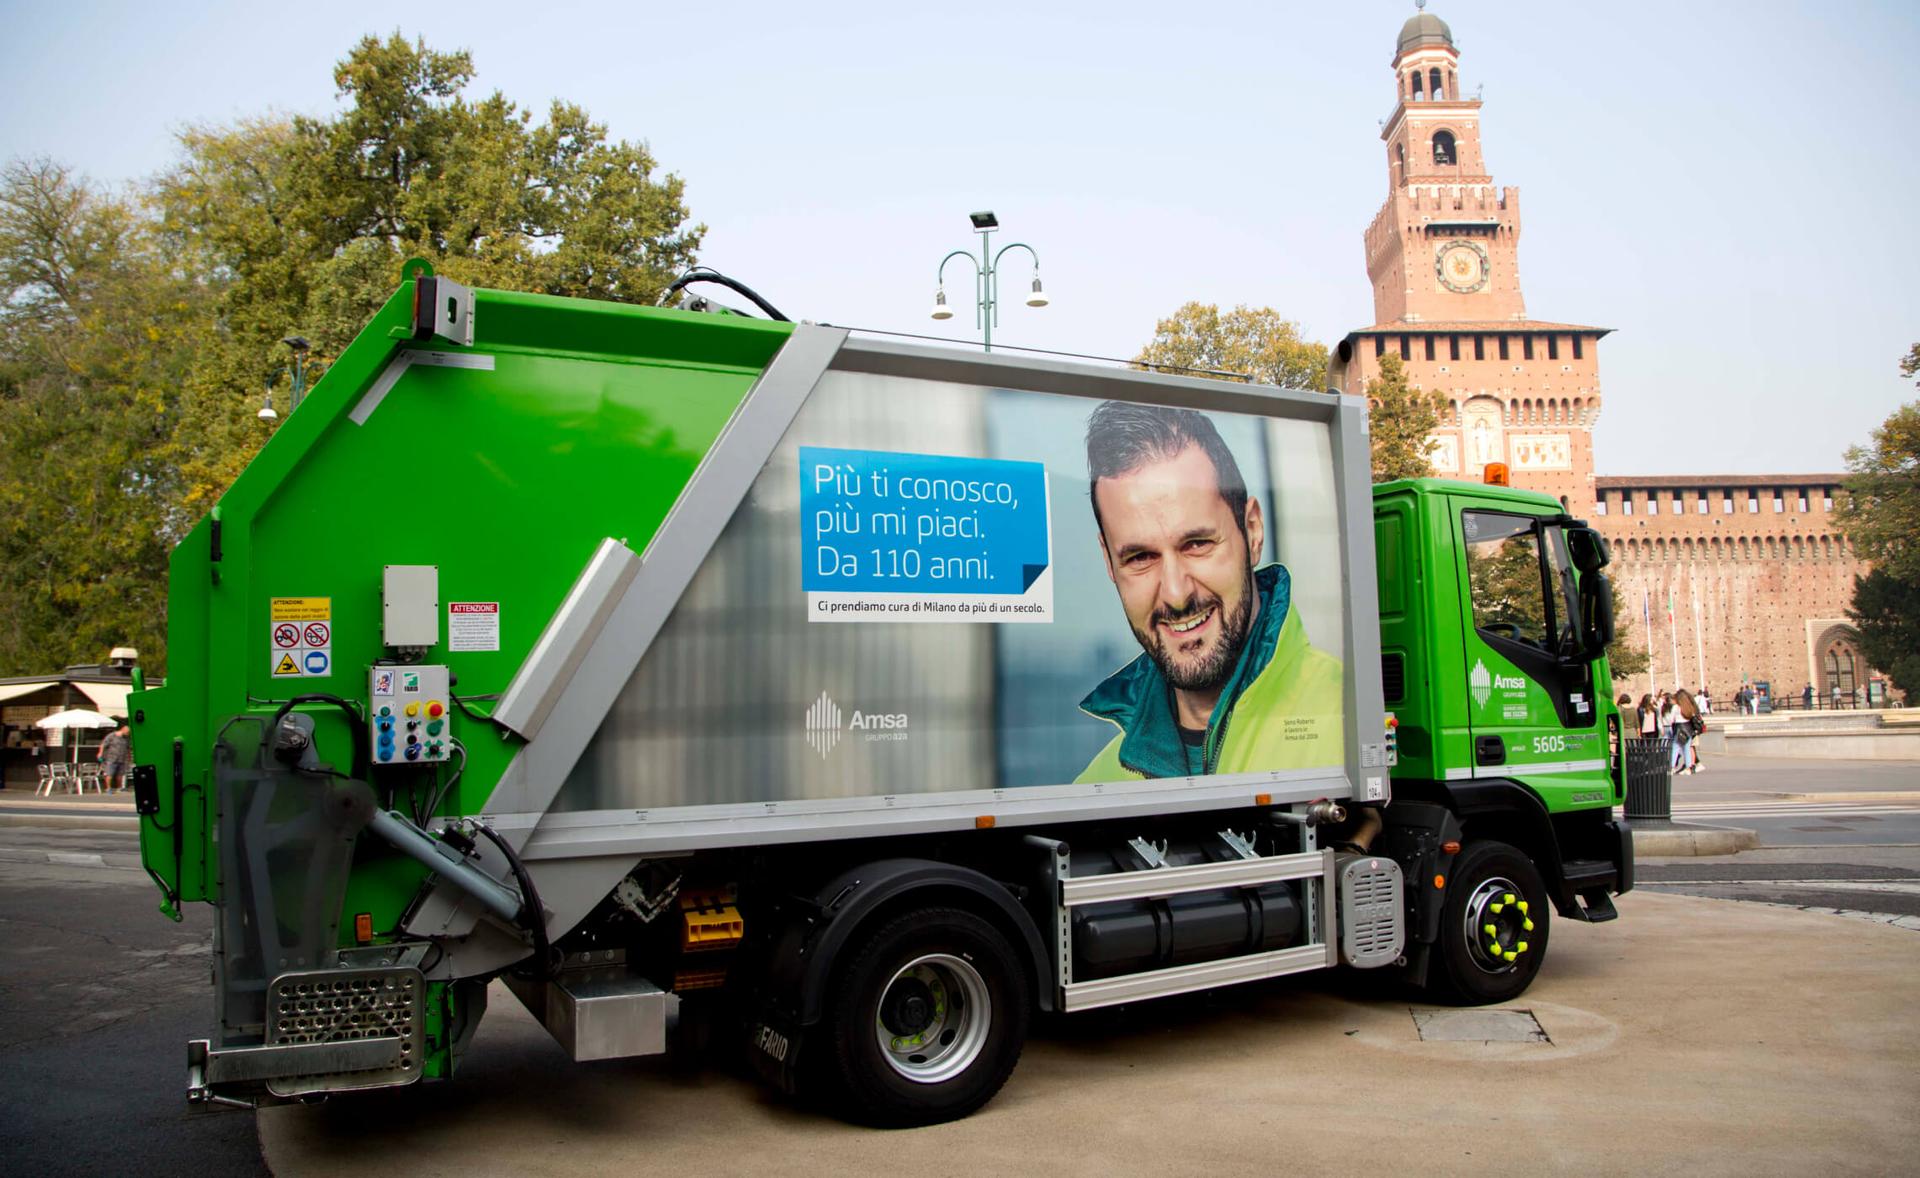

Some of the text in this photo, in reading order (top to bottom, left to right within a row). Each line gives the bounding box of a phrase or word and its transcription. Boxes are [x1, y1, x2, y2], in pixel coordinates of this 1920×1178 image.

[815, 464, 1019, 510] Più ti conosco,
[816, 502, 986, 545] più mi piaci.
[817, 545, 995, 580] Da 110 anni.
[453, 604, 496, 612] ATTENZIONE
[818, 601, 1045, 615] Ci prendiamo cura di Milano da più di un secolo.
[1494, 674, 1526, 689] Amsa
[849, 710, 908, 730] Amsa
[1533, 735, 1565, 753] 5605
[760, 1025, 788, 1062] FARID
